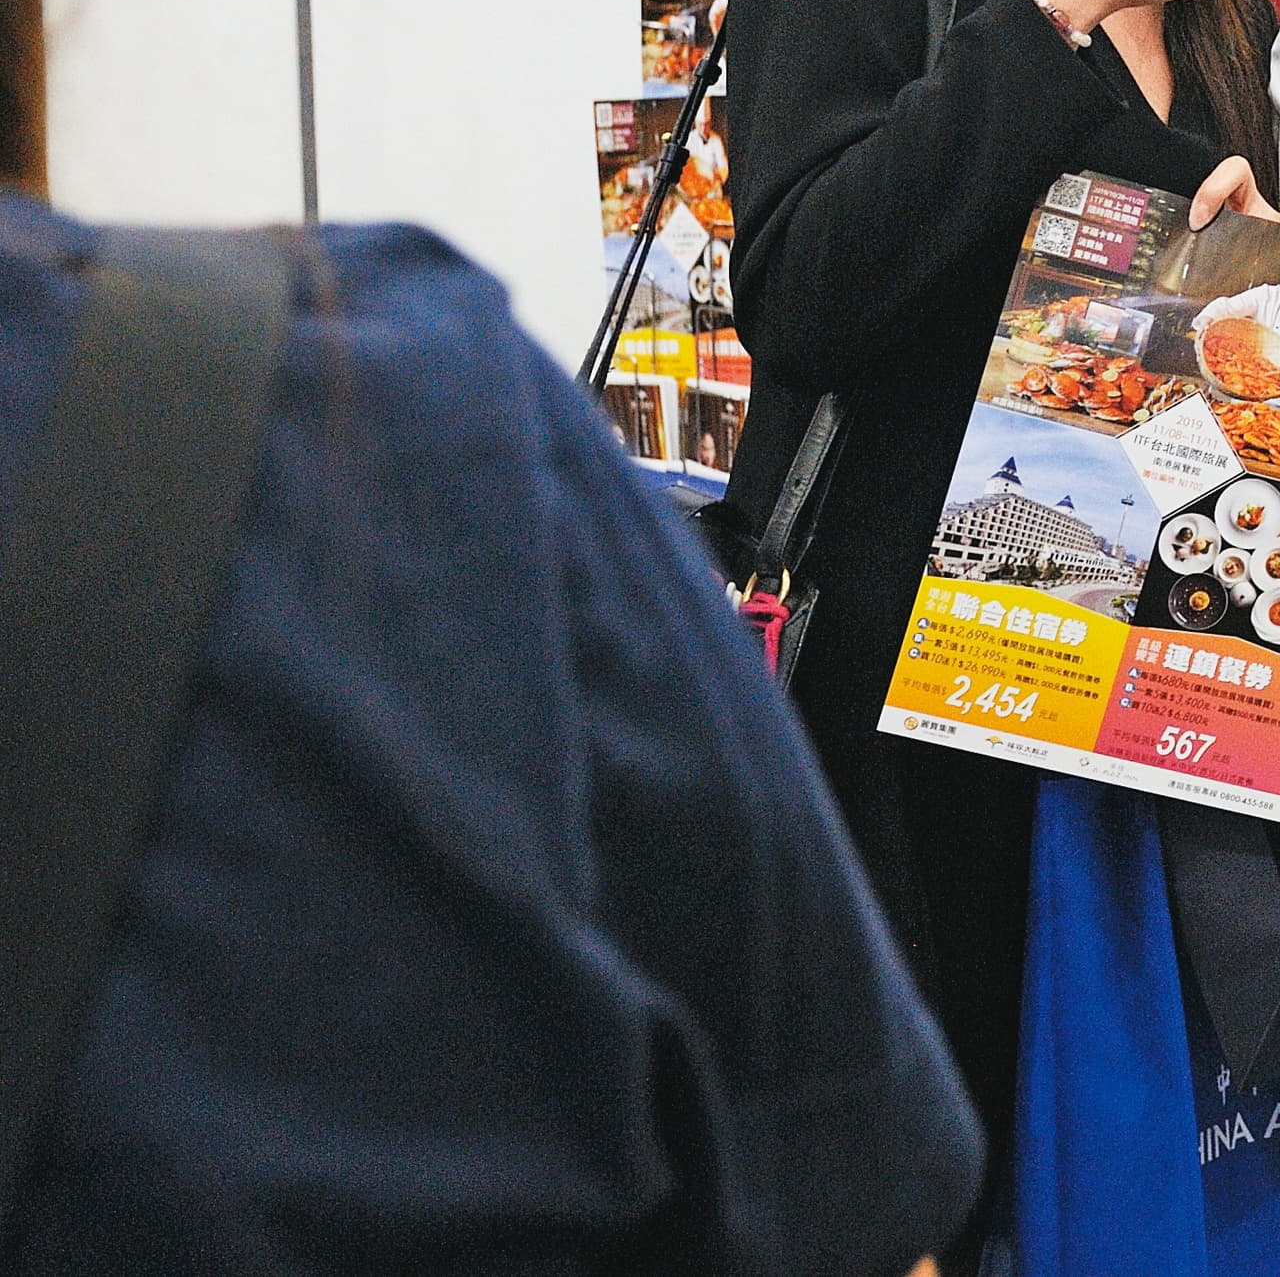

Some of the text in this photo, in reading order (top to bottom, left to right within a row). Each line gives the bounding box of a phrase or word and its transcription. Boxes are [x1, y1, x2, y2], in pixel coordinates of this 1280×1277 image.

[1176, 414, 1203, 430] 2019
[949, 590, 1088, 647] 聯合住宿券
[1162, 642, 1273, 690] 連鎖餐券
[945, 674, 1040, 723] 2,454
[1155, 724, 1217, 763] 567
